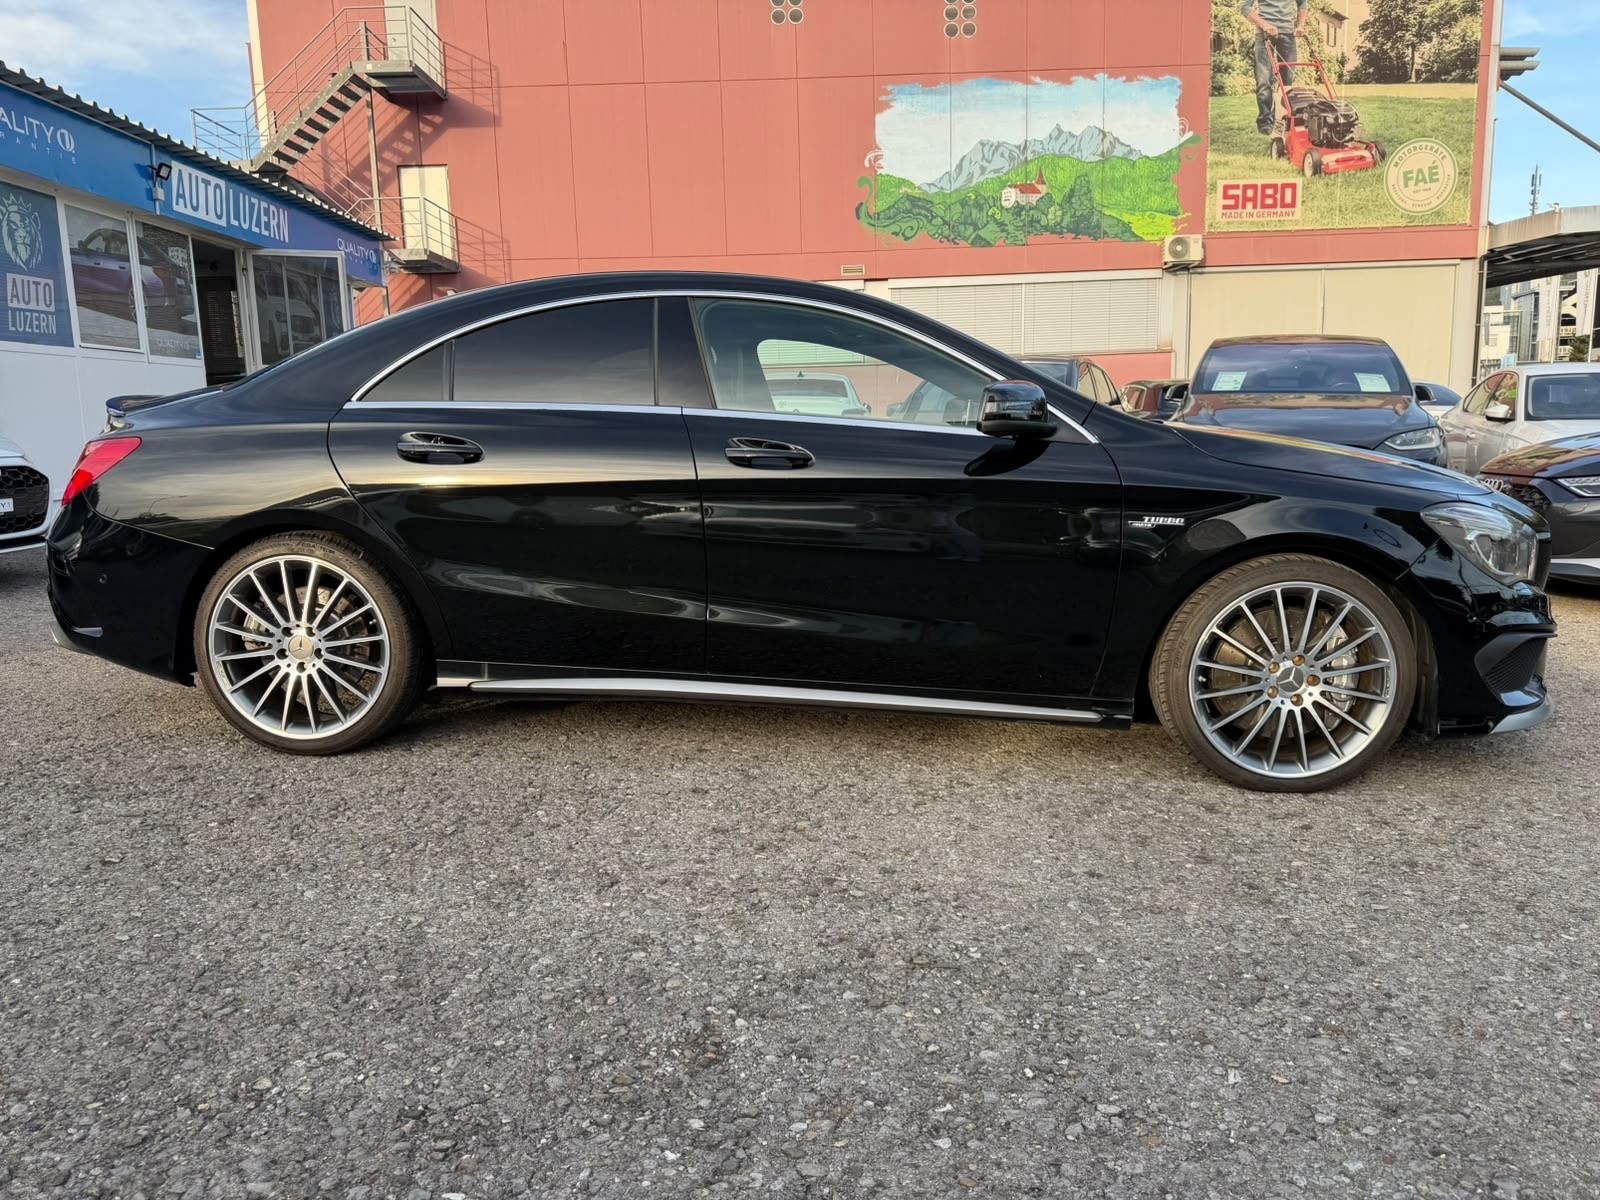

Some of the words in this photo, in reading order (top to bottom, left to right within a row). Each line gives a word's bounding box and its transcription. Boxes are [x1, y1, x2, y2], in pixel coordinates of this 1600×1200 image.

[1403, 160, 1440, 189] FAÉ
[176, 168, 224, 221] AUTO
[229, 188, 289, 243] LUZERN
[1222, 183, 1297, 210] SABO
[1221, 211, 1244, 219] MADE
[1256, 210, 1296, 218] GERMANY
[10, 277, 53, 308] AUTO
[8, 309, 57, 335] LUZERN
[1142, 516, 1184, 524] TURBO
